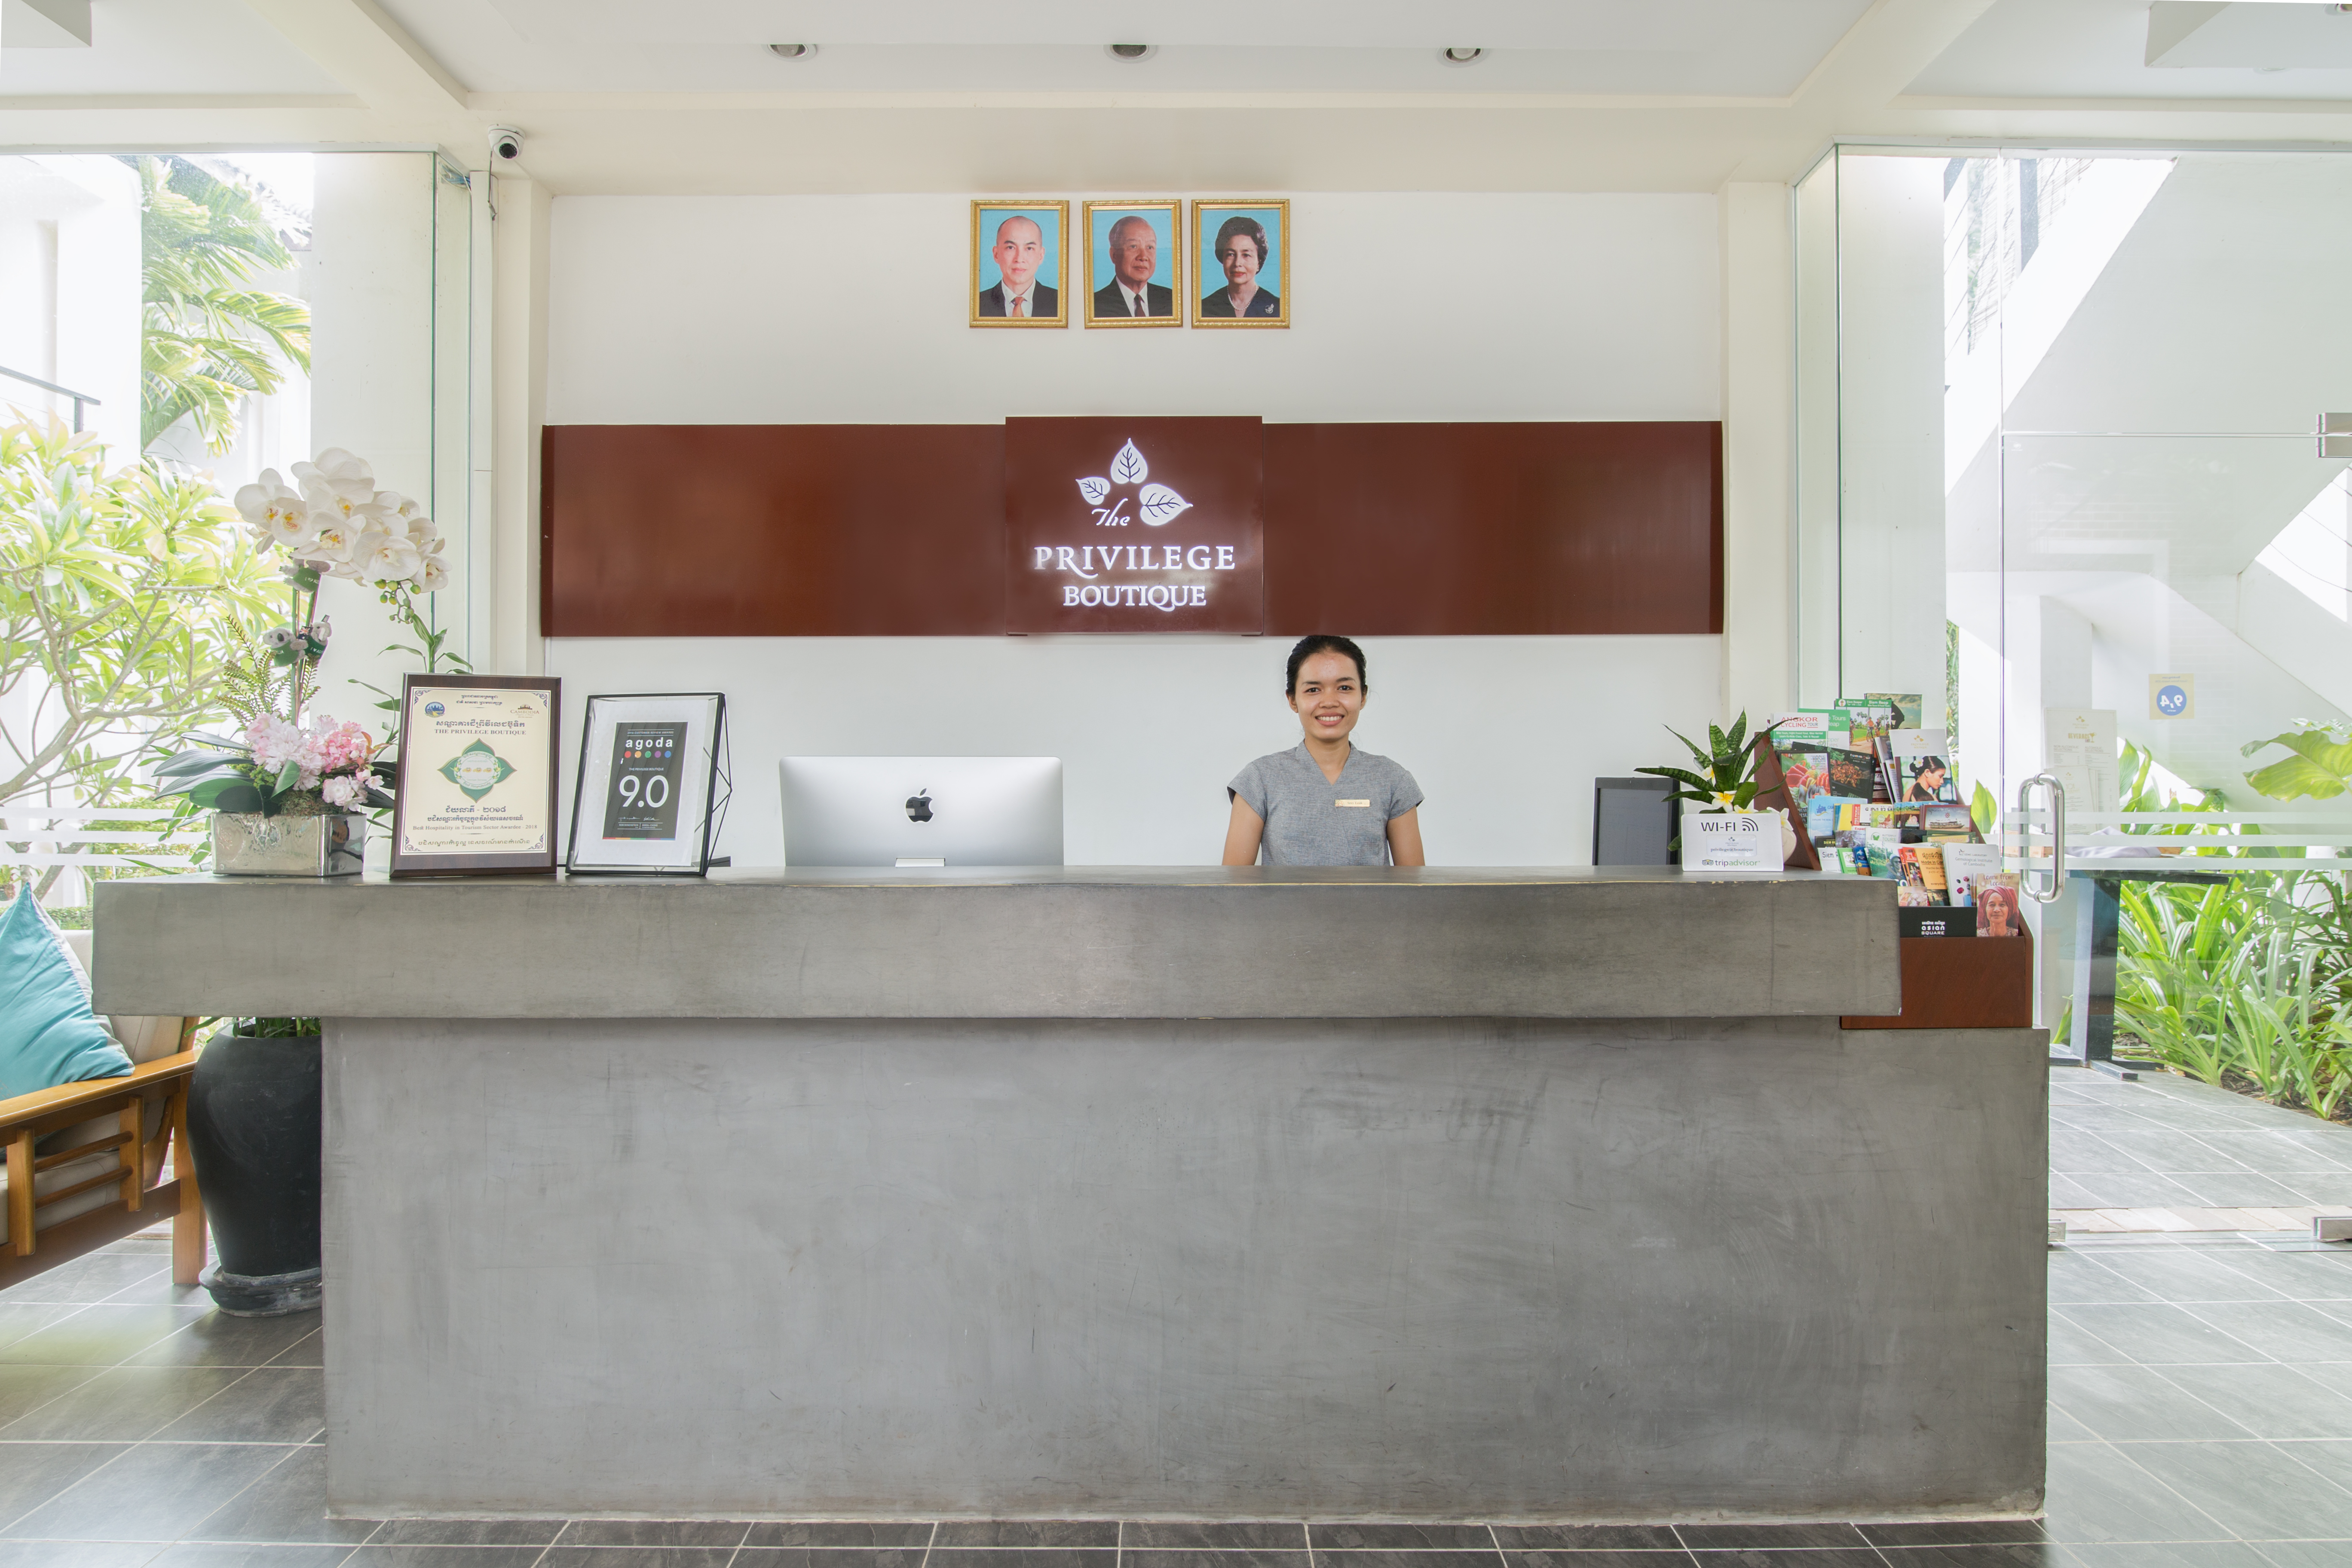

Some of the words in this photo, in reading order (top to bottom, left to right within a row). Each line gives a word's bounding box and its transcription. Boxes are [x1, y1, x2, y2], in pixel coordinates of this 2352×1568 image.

[1091, 498, 1130, 526] The
[1034, 545, 1235, 579] PRIVILEGE
[1063, 585, 1207, 612] BOUTIQUE
[625, 737, 673, 750] agoda
[619, 775, 669, 808] 9.0
[1701, 822, 1736, 831] WI-FI
